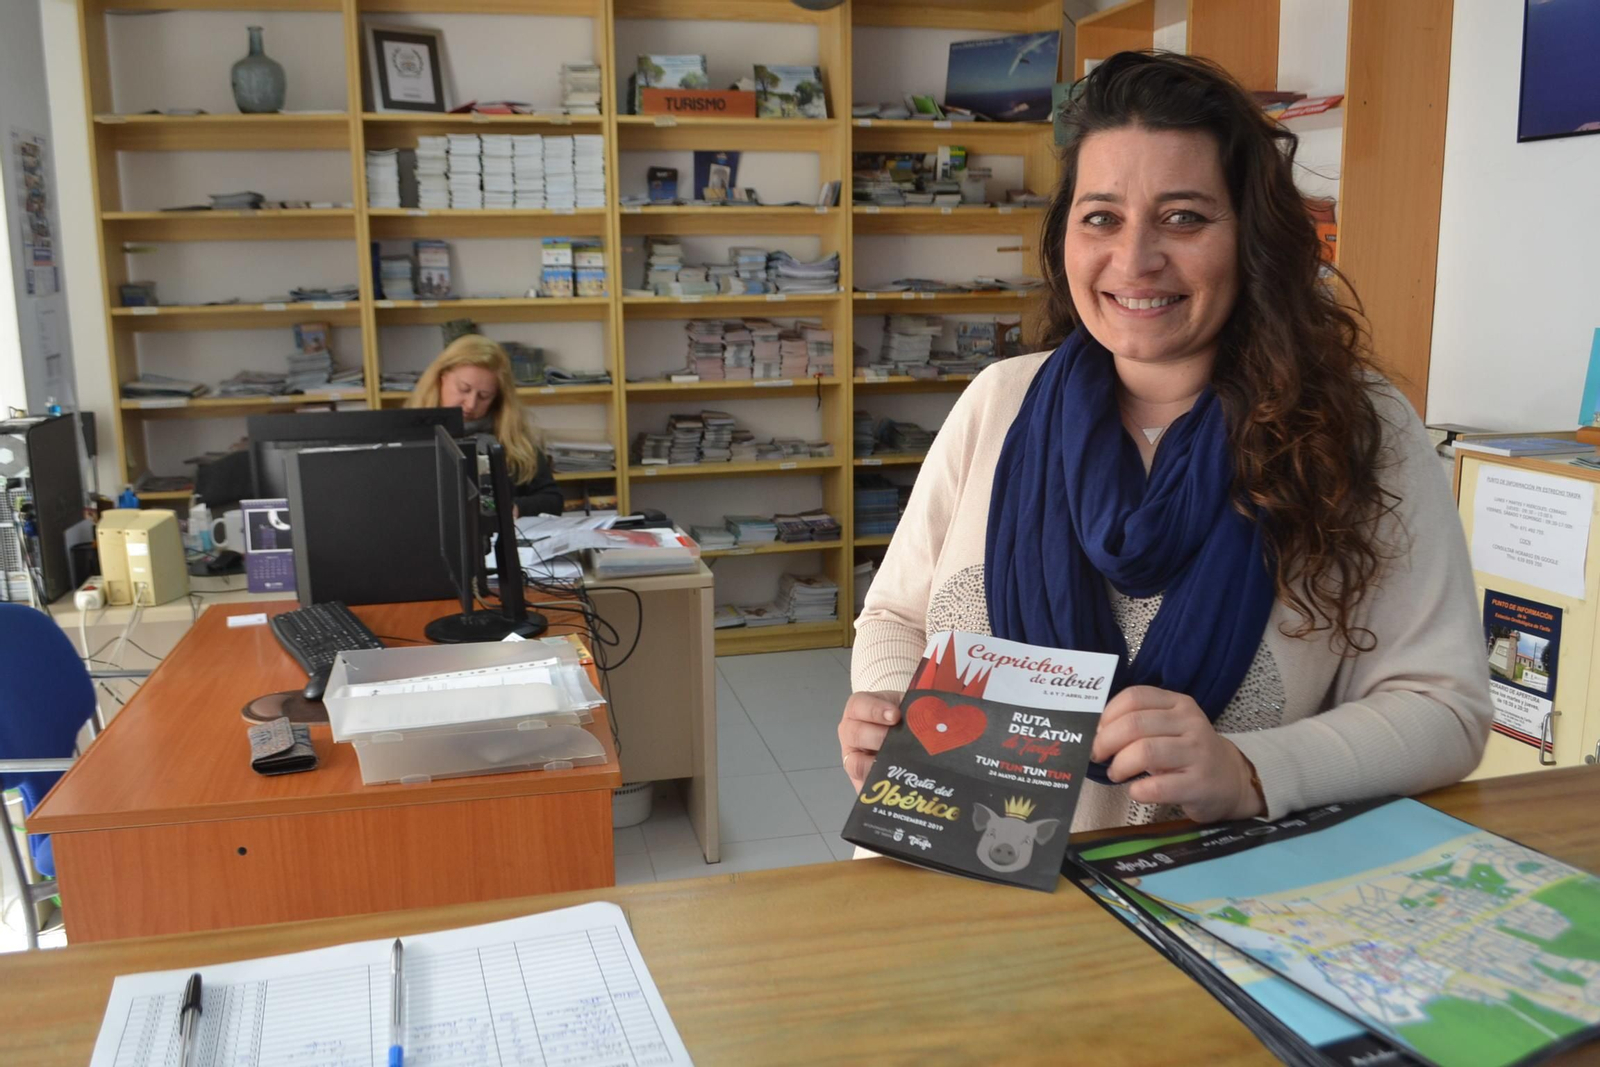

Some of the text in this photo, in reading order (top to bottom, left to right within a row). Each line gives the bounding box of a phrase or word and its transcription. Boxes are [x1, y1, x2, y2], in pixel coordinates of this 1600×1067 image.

[664, 96, 726, 111] TURISMO
[1492, 598, 1508, 608] PUNTO
[1517, 606, 1553, 620] INFORMACIÓN
[967, 644, 1074, 676] Caprichos
[1030, 673, 1105, 690] de abril
[1506, 695, 1520, 704] martes
[1516, 690, 1540, 703] APERTURA
[1012, 712, 1052, 728] RUTA
[1008, 723, 1036, 738] DEL
[887, 766, 954, 798] VI Ruta del
[998, 772, 1016, 780] MAYO
[1032, 778, 1052, 787] JUNIO
[1052, 782, 1070, 790] 2019
[860, 780, 960, 820] Ibérico
[892, 812, 927, 828] DICIEMBRE
[928, 821, 944, 832] 2019
